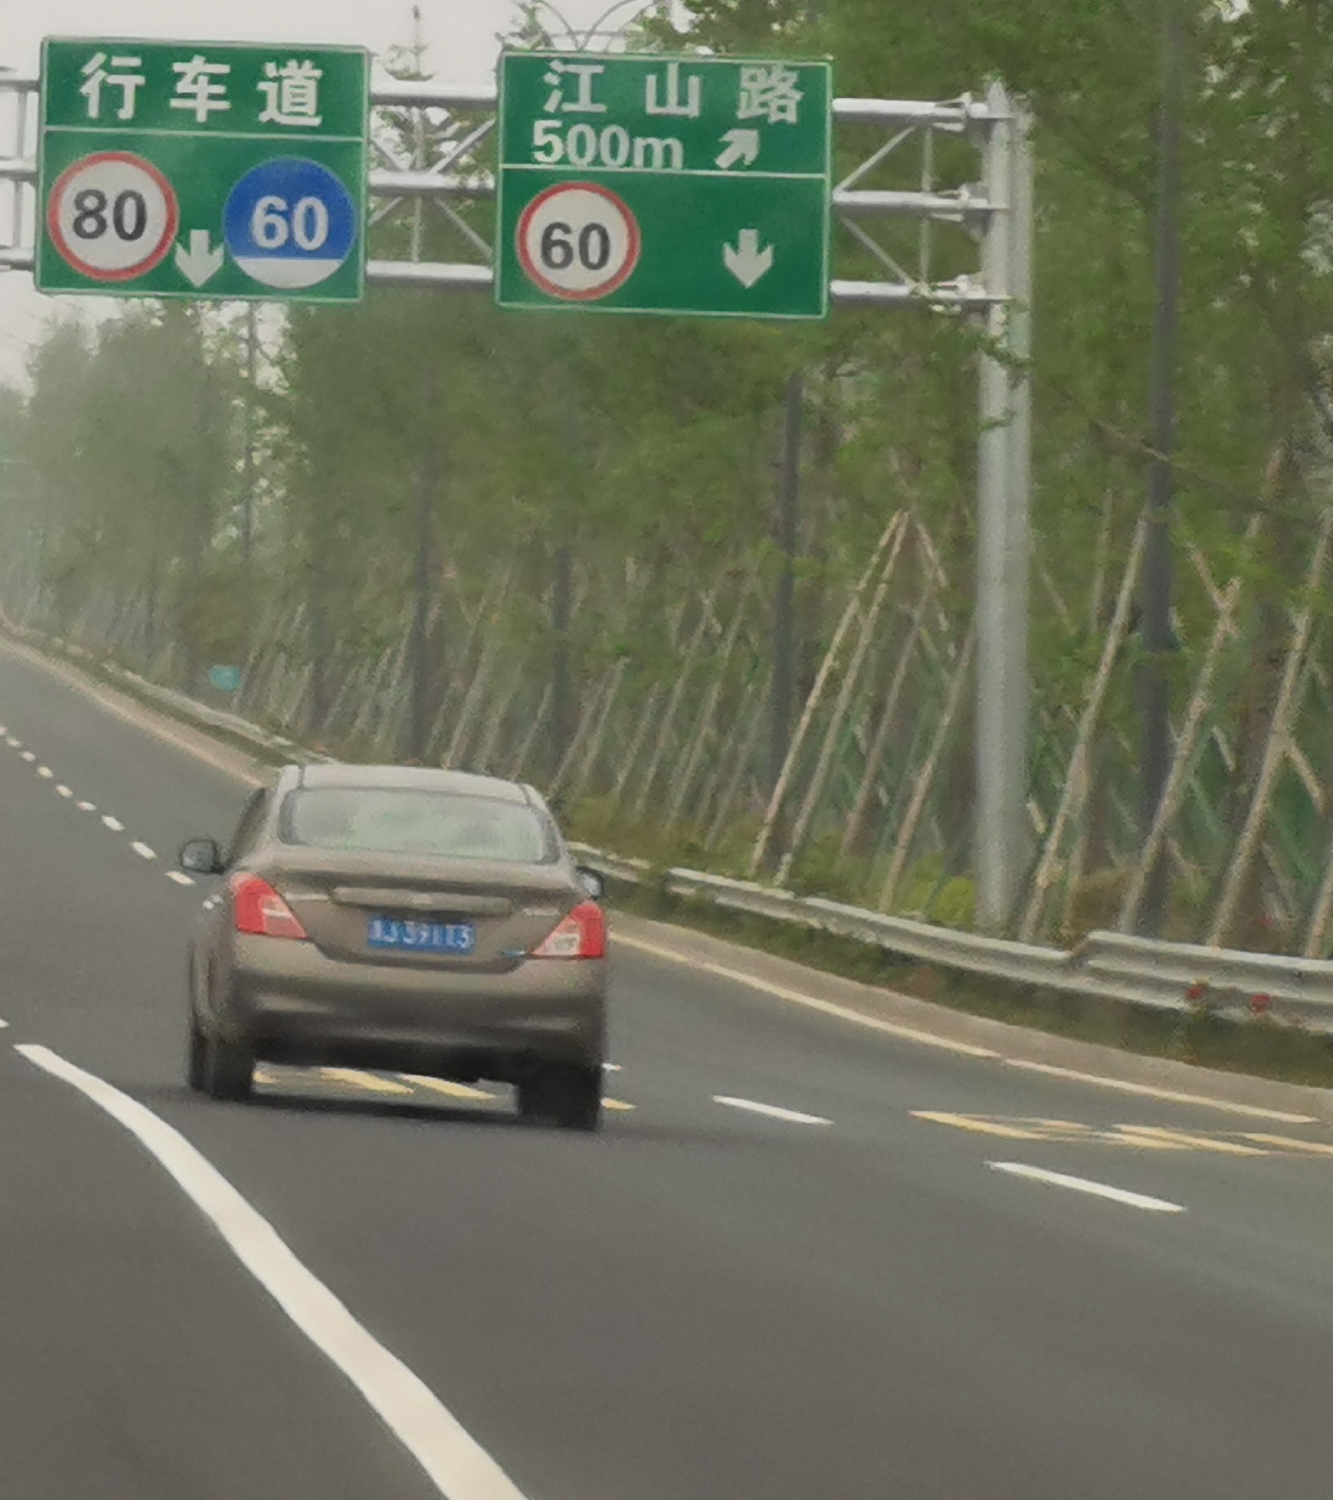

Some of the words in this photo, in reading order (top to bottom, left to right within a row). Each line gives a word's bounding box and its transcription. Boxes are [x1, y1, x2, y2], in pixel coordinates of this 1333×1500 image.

[80, 52, 323, 127] 行车道
[543, 58, 805, 124] 江山路
[533, 119, 683, 169] 500m
[72, 189, 147, 241] 80
[251, 195, 329, 250] 60
[540, 222, 611, 270] 60
